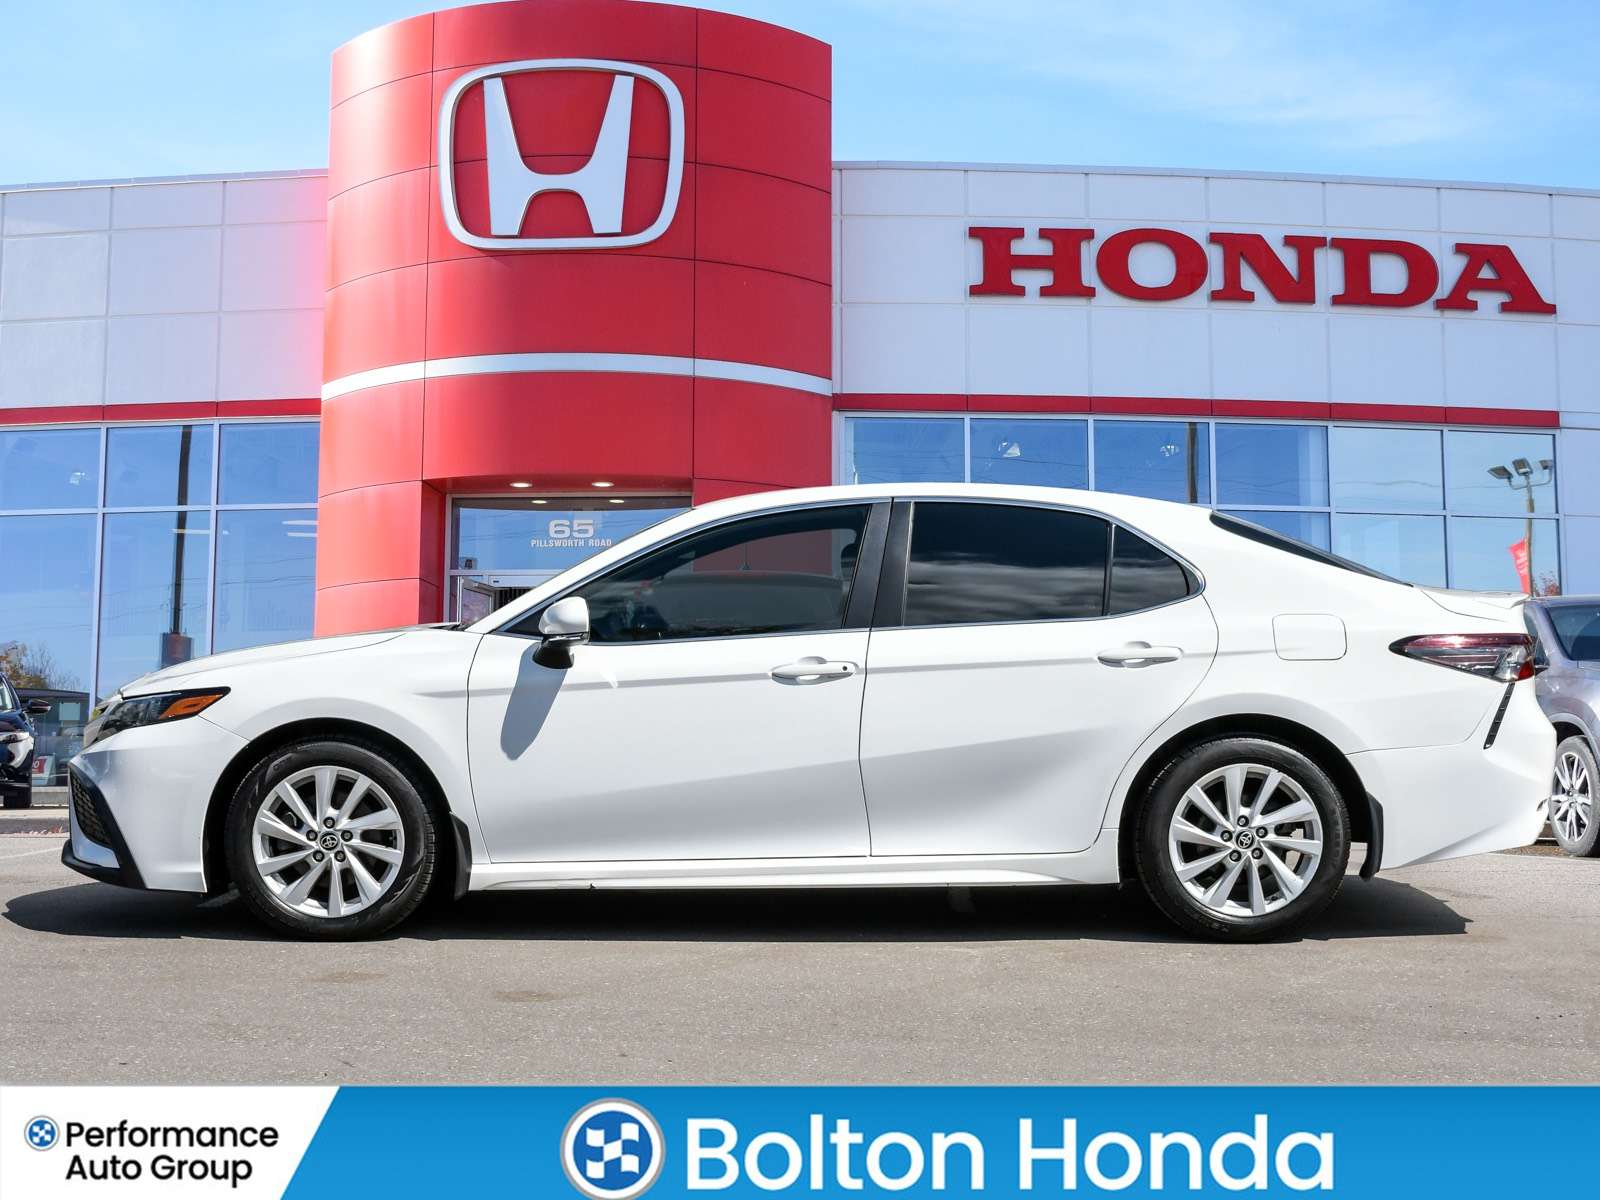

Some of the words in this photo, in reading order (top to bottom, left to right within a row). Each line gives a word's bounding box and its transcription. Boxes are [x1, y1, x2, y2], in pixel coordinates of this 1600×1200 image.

[968, 226, 1556, 314] HONDA
[548, 519, 594, 538] 65
[530, 538, 585, 548] PILLSWORTH
[588, 538, 612, 547] ROAD
